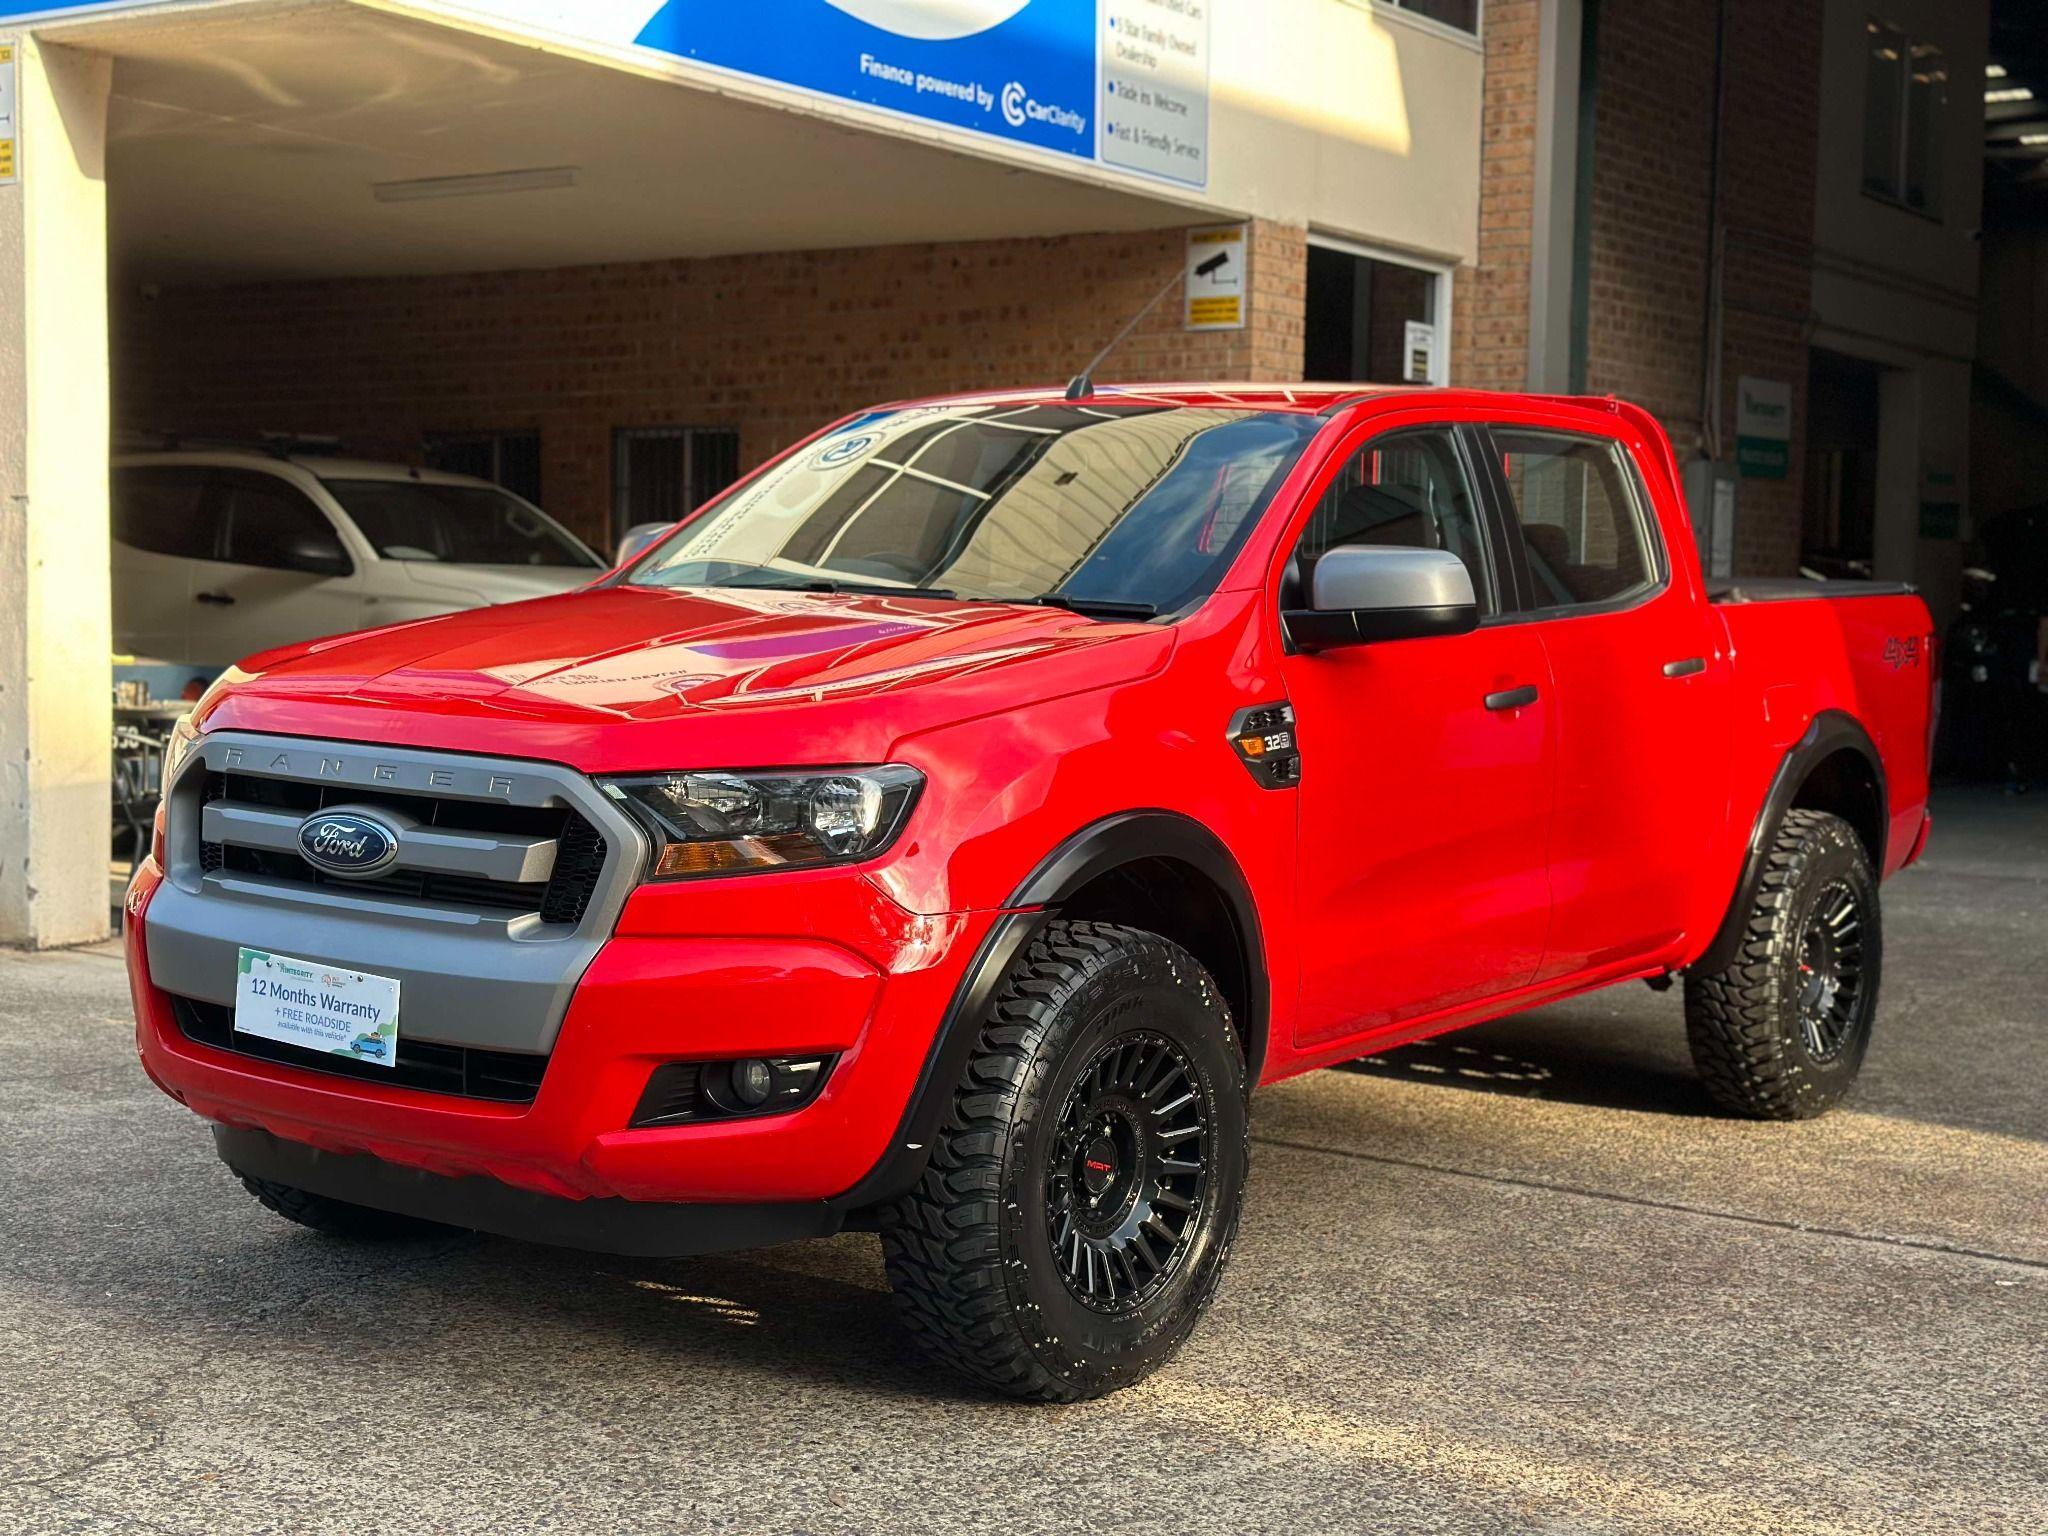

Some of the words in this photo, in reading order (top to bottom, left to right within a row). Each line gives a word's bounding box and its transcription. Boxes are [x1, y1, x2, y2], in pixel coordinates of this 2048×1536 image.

[1116, 41, 1157, 69] Dealership
[860, 53, 915, 86] Finance
[916, 73, 975, 102] powered
[976, 84, 995, 112] by
[1025, 99, 1087, 134] CarClarity
[1142, 129, 1171, 156] Friendly
[1174, 137, 1200, 160] Service
[225, 747, 514, 795] RANGER
[314, 822, 369, 858] Ford
[251, 978, 267, 996] 12
[270, 982, 316, 1007] Months
[320, 992, 381, 1023] Warranty
[282, 1007, 303, 1022] FREE
[305, 1013, 351, 1032] ROADSIDE
[301, 1026, 314, 1036] with
[314, 1029, 324, 1038] this
